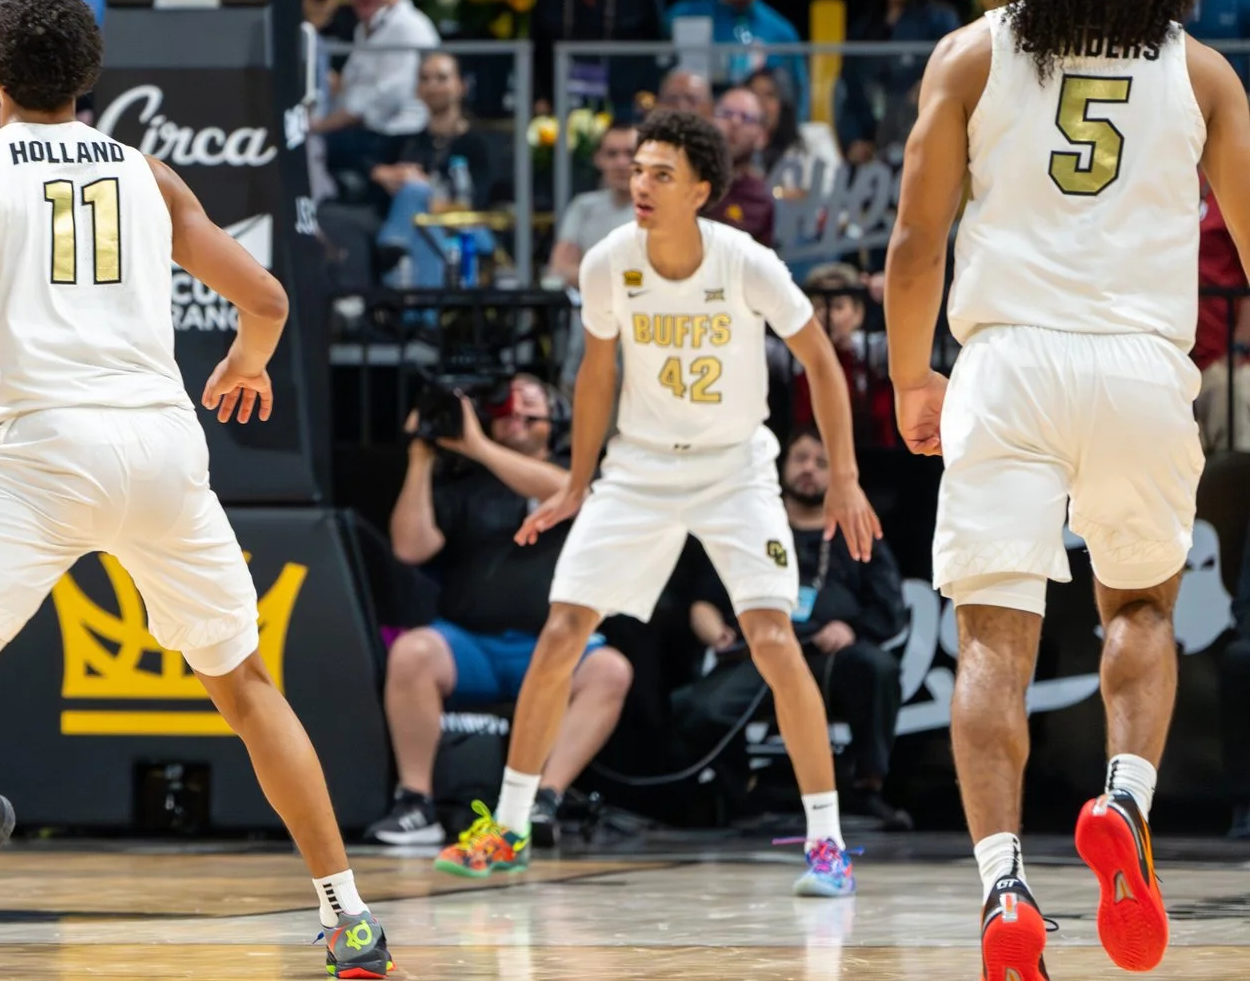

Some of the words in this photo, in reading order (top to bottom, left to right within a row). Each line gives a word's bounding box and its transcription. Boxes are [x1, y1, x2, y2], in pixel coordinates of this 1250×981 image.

[9, 140, 125, 166] HOLLAND
[96, 84, 278, 166] Circa
[1048, 74, 1133, 196] 5
[43, 177, 122, 285] 11
[632, 312, 731, 349] BUFFS
[658, 355, 722, 404] 42
